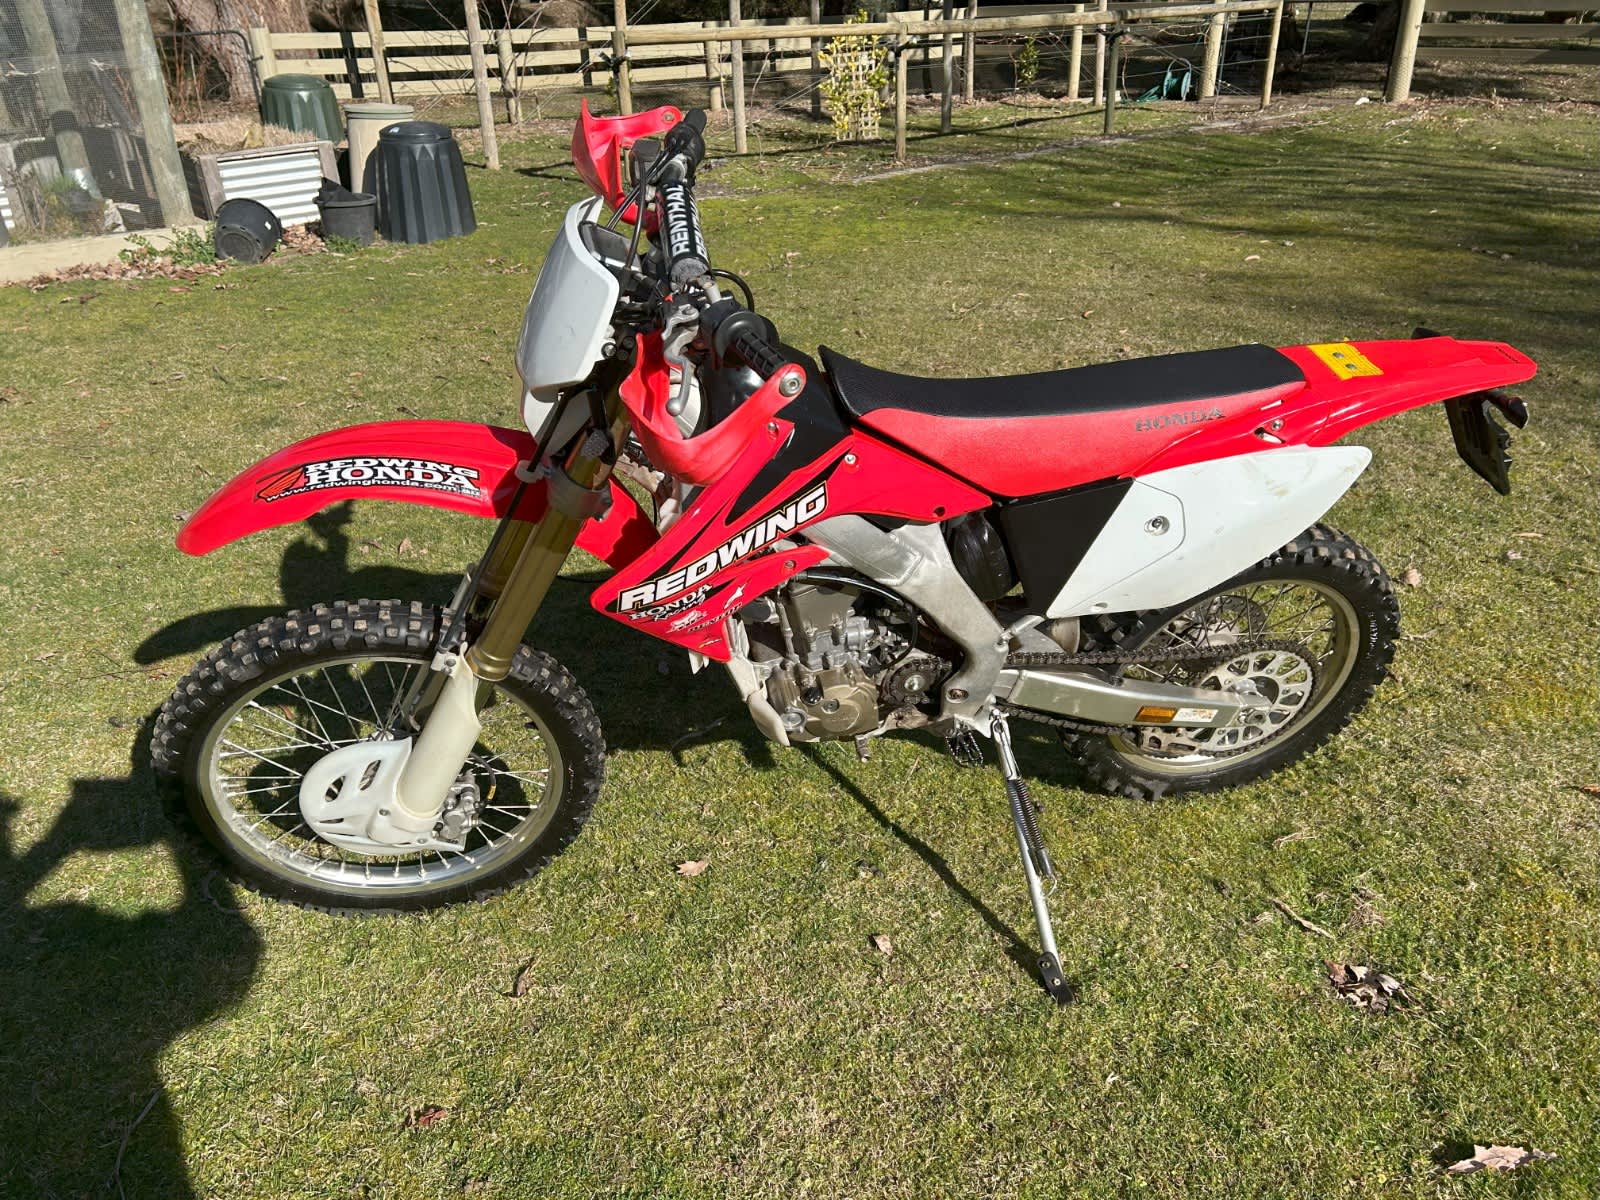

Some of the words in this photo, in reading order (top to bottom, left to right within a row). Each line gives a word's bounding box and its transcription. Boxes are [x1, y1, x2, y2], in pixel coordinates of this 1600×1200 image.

[666, 184, 690, 257] RENTHAL
[1135, 407, 1226, 432] HONDA
[306, 457, 480, 479] REDWING
[306, 466, 481, 491] HONDA
[266, 477, 481, 501] www.redwinghonda.com.au
[619, 484, 826, 612] REDWING
[629, 583, 713, 621] HONDA
[653, 593, 706, 622] Racing
